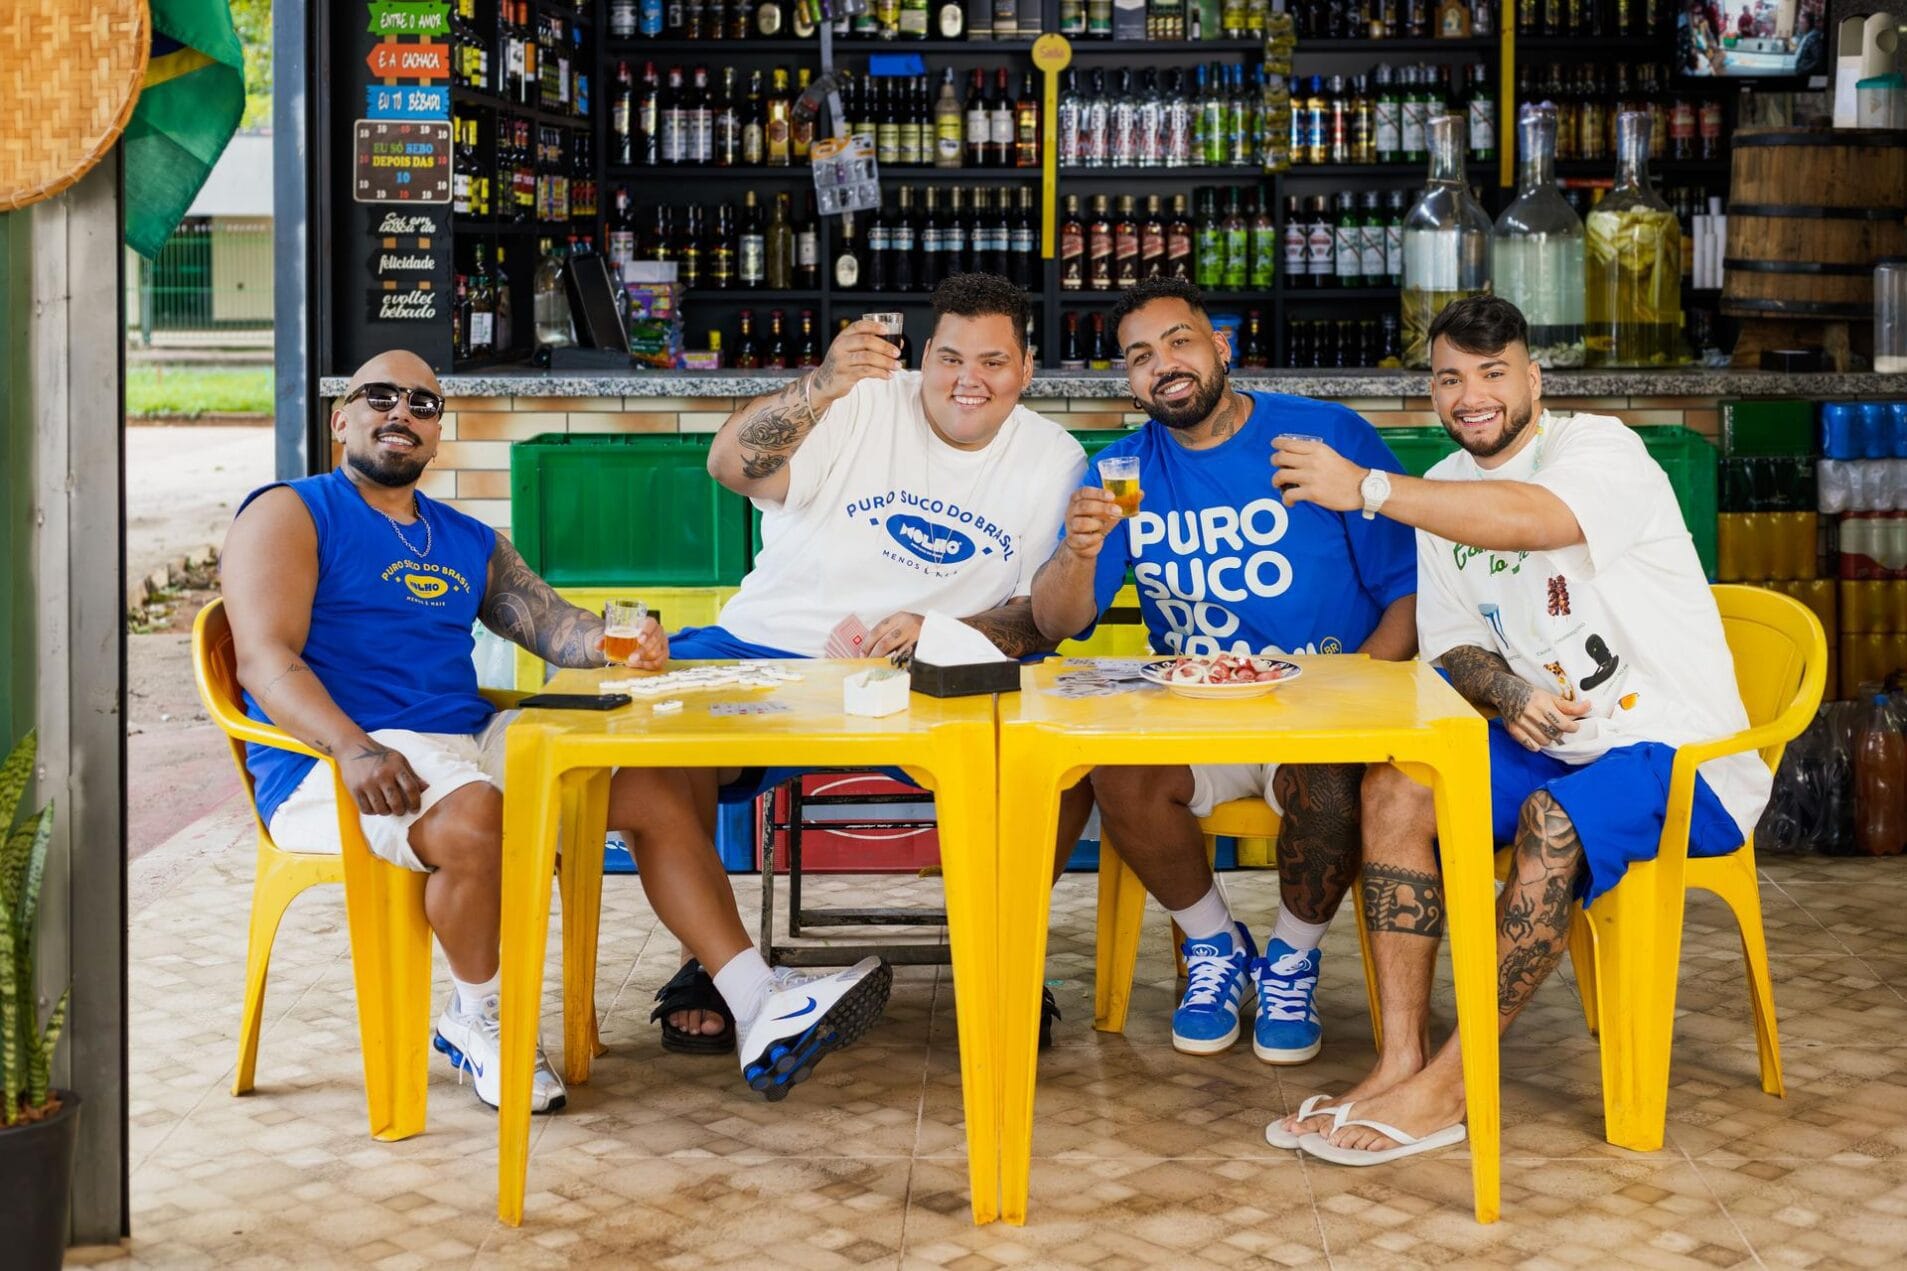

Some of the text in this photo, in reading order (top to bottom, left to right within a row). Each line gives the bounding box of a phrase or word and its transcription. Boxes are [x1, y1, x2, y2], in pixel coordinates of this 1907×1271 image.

[380, 12, 441, 29] ENTRE O AMOR
[389, 53, 396, 67] A
[378, 92, 389, 110] EU
[373, 143, 388, 153] EU
[406, 143, 434, 154] BEBO
[373, 156, 434, 168] DEPOIS DAS
[396, 171, 411, 184] 10
[378, 254, 435, 275] felicidade
[847, 491, 895, 518] PURO
[901, 490, 943, 513] SUCO
[947, 505, 973, 523] DO
[975, 516, 1014, 562] BRASIL
[1129, 498, 1289, 558] PURO
[882, 549, 920, 570] MENOS
[381, 561, 404, 581] PURO
[423, 563, 440, 572] DO
[442, 566, 471, 594] BRASIL
[1134, 551, 1293, 602] SUCO
[1155, 600, 1240, 638] DO
